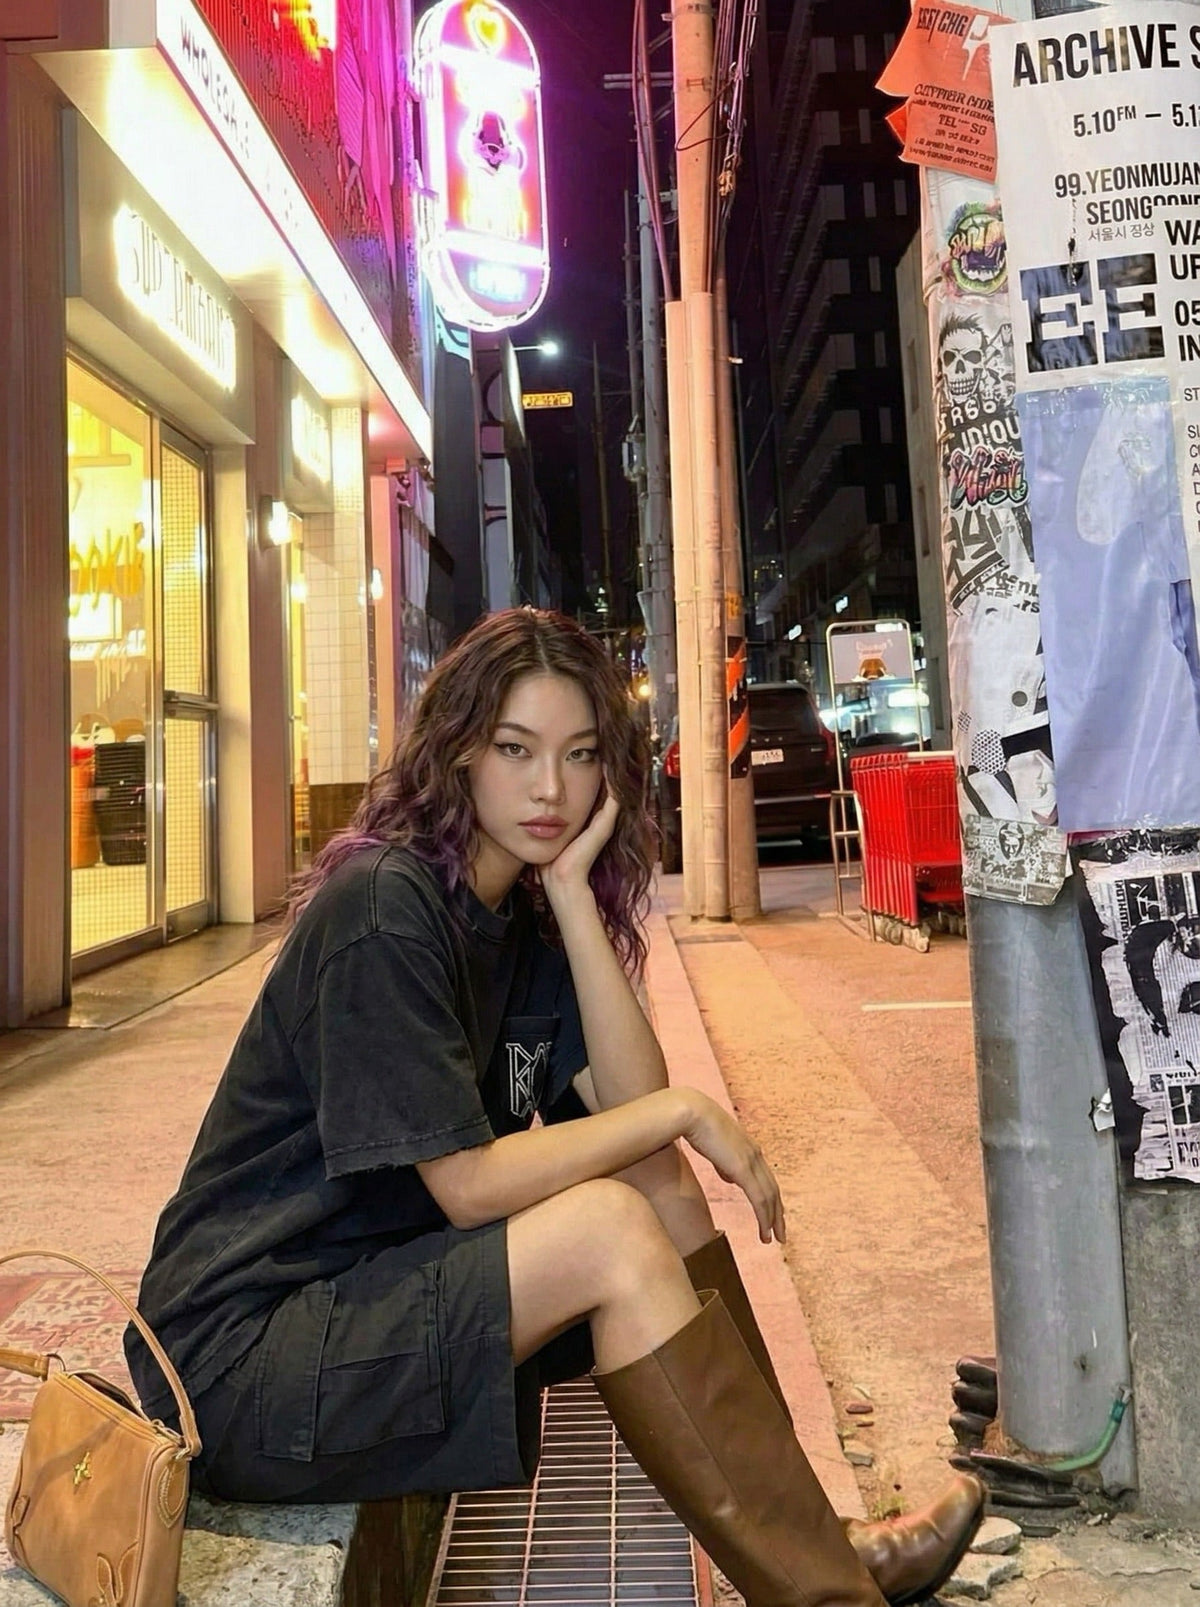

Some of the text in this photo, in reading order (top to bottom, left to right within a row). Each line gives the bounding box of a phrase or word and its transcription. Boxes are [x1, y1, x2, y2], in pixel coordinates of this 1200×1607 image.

[1013, 23, 1180, 88] ARCHIVE
[1171, 103, 1200, 127] 5.1
[1088, 224, 1127, 242] 서울시
